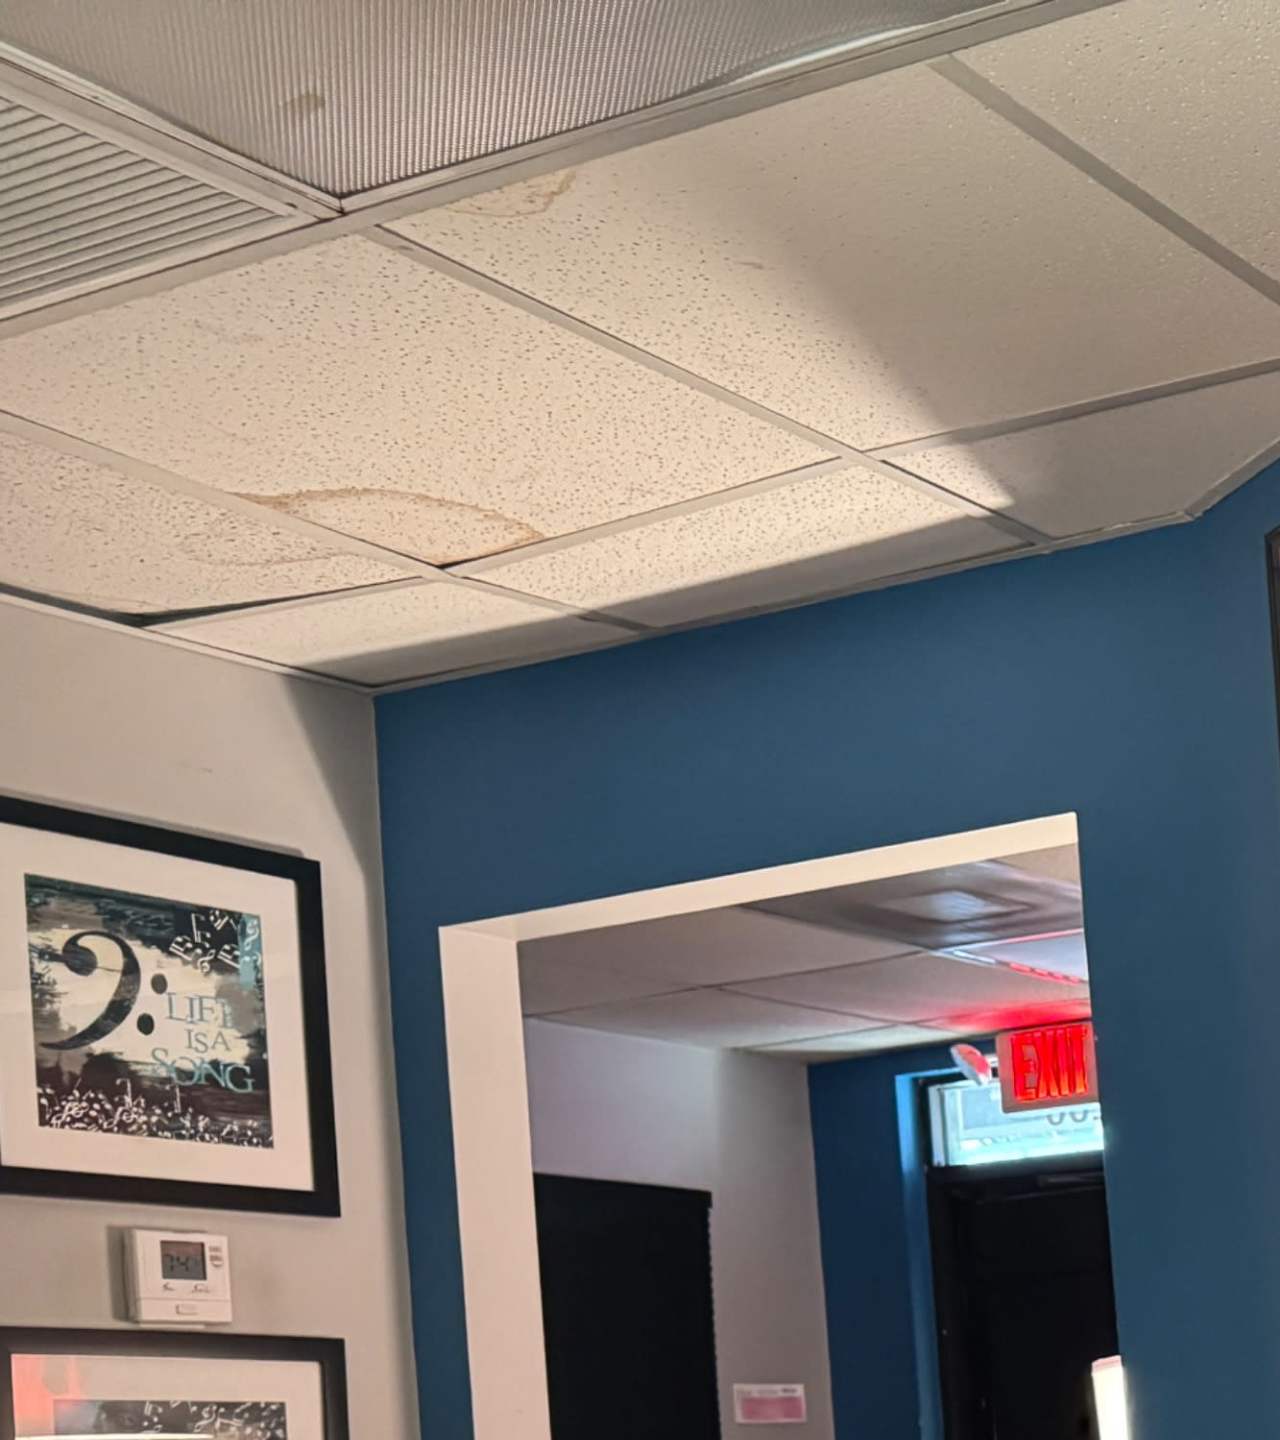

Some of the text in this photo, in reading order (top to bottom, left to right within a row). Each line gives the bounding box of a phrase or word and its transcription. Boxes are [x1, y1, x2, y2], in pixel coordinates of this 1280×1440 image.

[165, 991, 234, 1029] LIFE
[184, 1028, 232, 1054] IS A
[151, 1047, 256, 1094] SONG
[1010, 1026, 1089, 1103] EXIT
